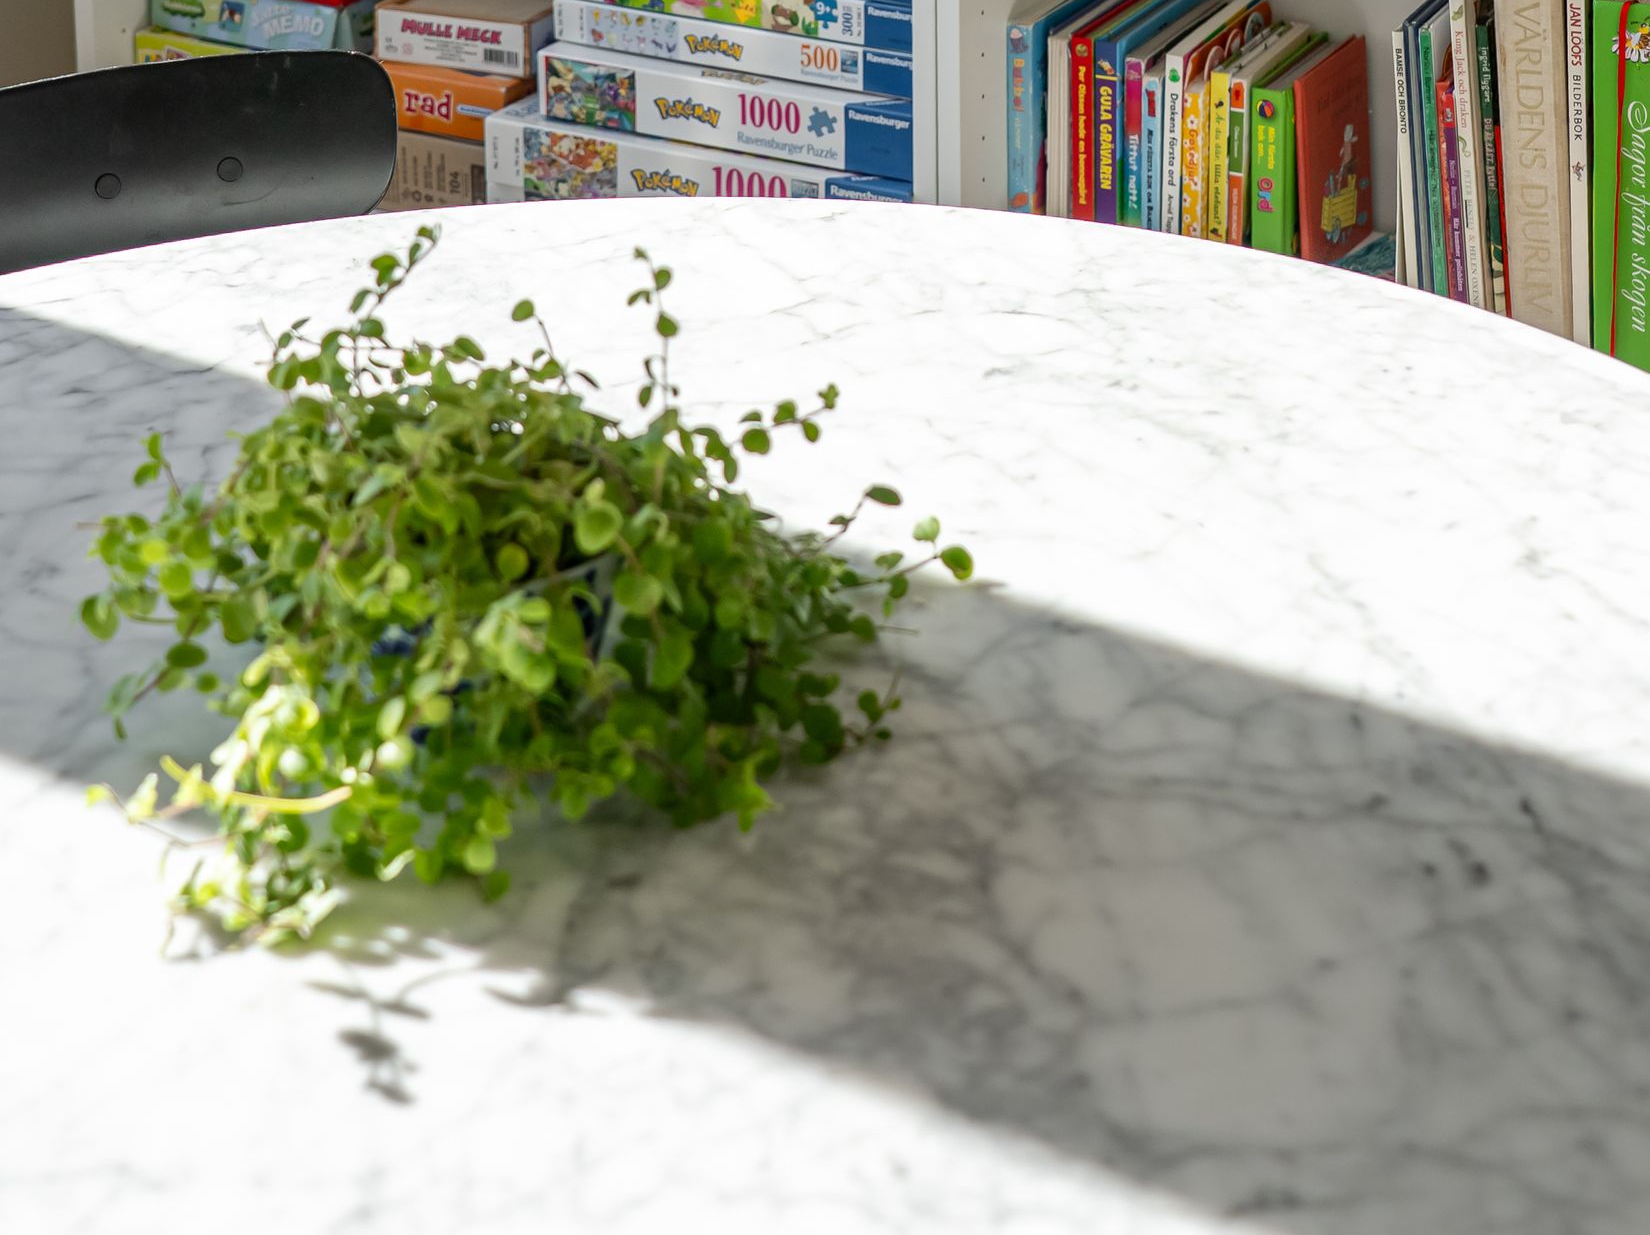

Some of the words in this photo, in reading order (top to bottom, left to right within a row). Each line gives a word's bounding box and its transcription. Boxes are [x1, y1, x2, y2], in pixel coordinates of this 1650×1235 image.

[815, 1, 831, 15] 9+
[1569, 3, 1581, 26] JAN
[264, 16, 325, 38] MEMO
[401, 18, 453, 39] MULLE
[457, 26, 502, 45] MECK
[842, 12, 853, 37] 300
[684, 33, 744, 62] Pokémon
[1454, 30, 1464, 54] Kung
[1570, 30, 1584, 66] LÖÖFS
[800, 44, 839, 72] 500
[1395, 48, 1403, 77] BAMSE
[1455, 57, 1465, 77] Jack
[1479, 46, 1490, 71] ingrid
[1078, 84, 1086, 113] Olsson
[1457, 79, 1466, 94] och
[1513, 1, 1549, 171] VÄRLDENS
[404, 91, 453, 122] rad
[654, 97, 721, 128] Pokémon
[738, 94, 801, 134] 1000
[1100, 85, 1112, 120] GULA
[1169, 93, 1178, 132] Drakens
[1398, 99, 1407, 133] BRONTO
[1458, 97, 1469, 128] draken
[1571, 74, 1584, 140] BILDERBOK
[849, 109, 910, 130] Ravensburger
[1078, 115, 1086, 138] hade
[737, 131, 804, 156] Ravensburger
[807, 138, 838, 161] Puzzle
[1079, 140, 1084, 151] en
[1099, 123, 1114, 189] GRÄVAREN
[1128, 134, 1138, 170] Tittut
[1168, 136, 1177, 166] första
[1621, 101, 1650, 189] Sagor
[631, 168, 699, 198] Pokémon
[712, 166, 787, 198] 1000
[1127, 174, 1137, 208] natt!
[1167, 169, 1175, 185] ord
[1213, 186, 1221, 225] elefant?
[1256, 177, 1275, 213] Ord
[1463, 169, 1471, 195] PETER
[1469, 245, 1477, 274] HELEN
[1621, 191, 1650, 246] från
[1516, 182, 1553, 315] DJURLIV
[1621, 252, 1650, 333] skogen
